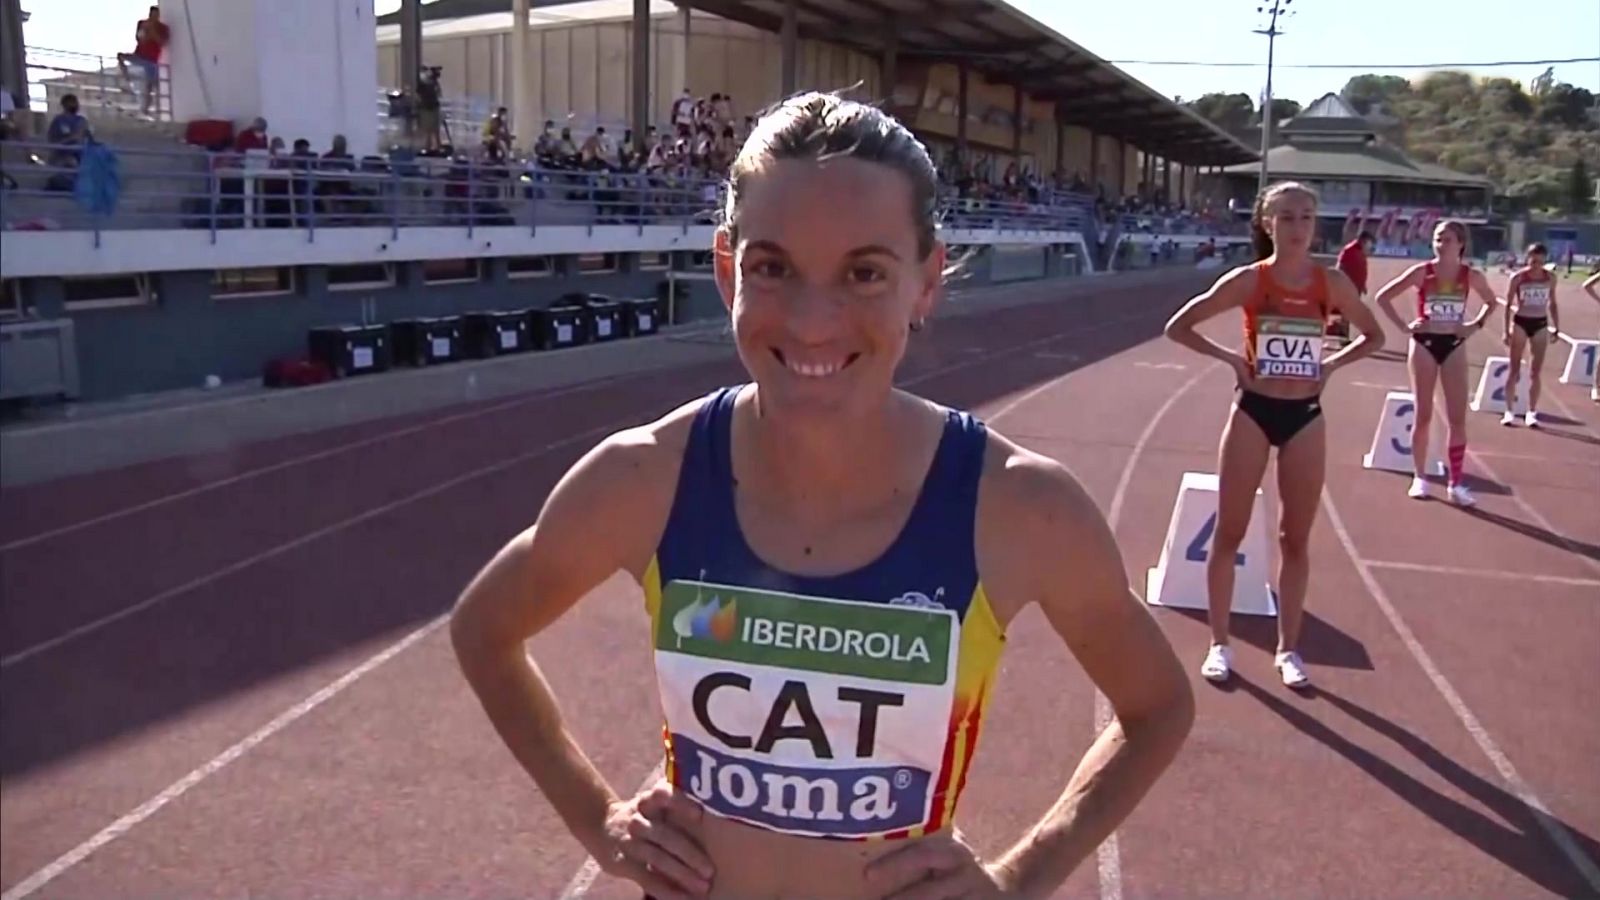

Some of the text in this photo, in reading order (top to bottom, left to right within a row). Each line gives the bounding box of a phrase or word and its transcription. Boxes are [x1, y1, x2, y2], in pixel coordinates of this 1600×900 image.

[1430, 304, 1456, 314] CYL
[1265, 337, 1314, 360] CVA
[1582, 345, 1596, 376] 1
[742, 616, 930, 663] IBERDROLA
[691, 671, 905, 759] CAT
